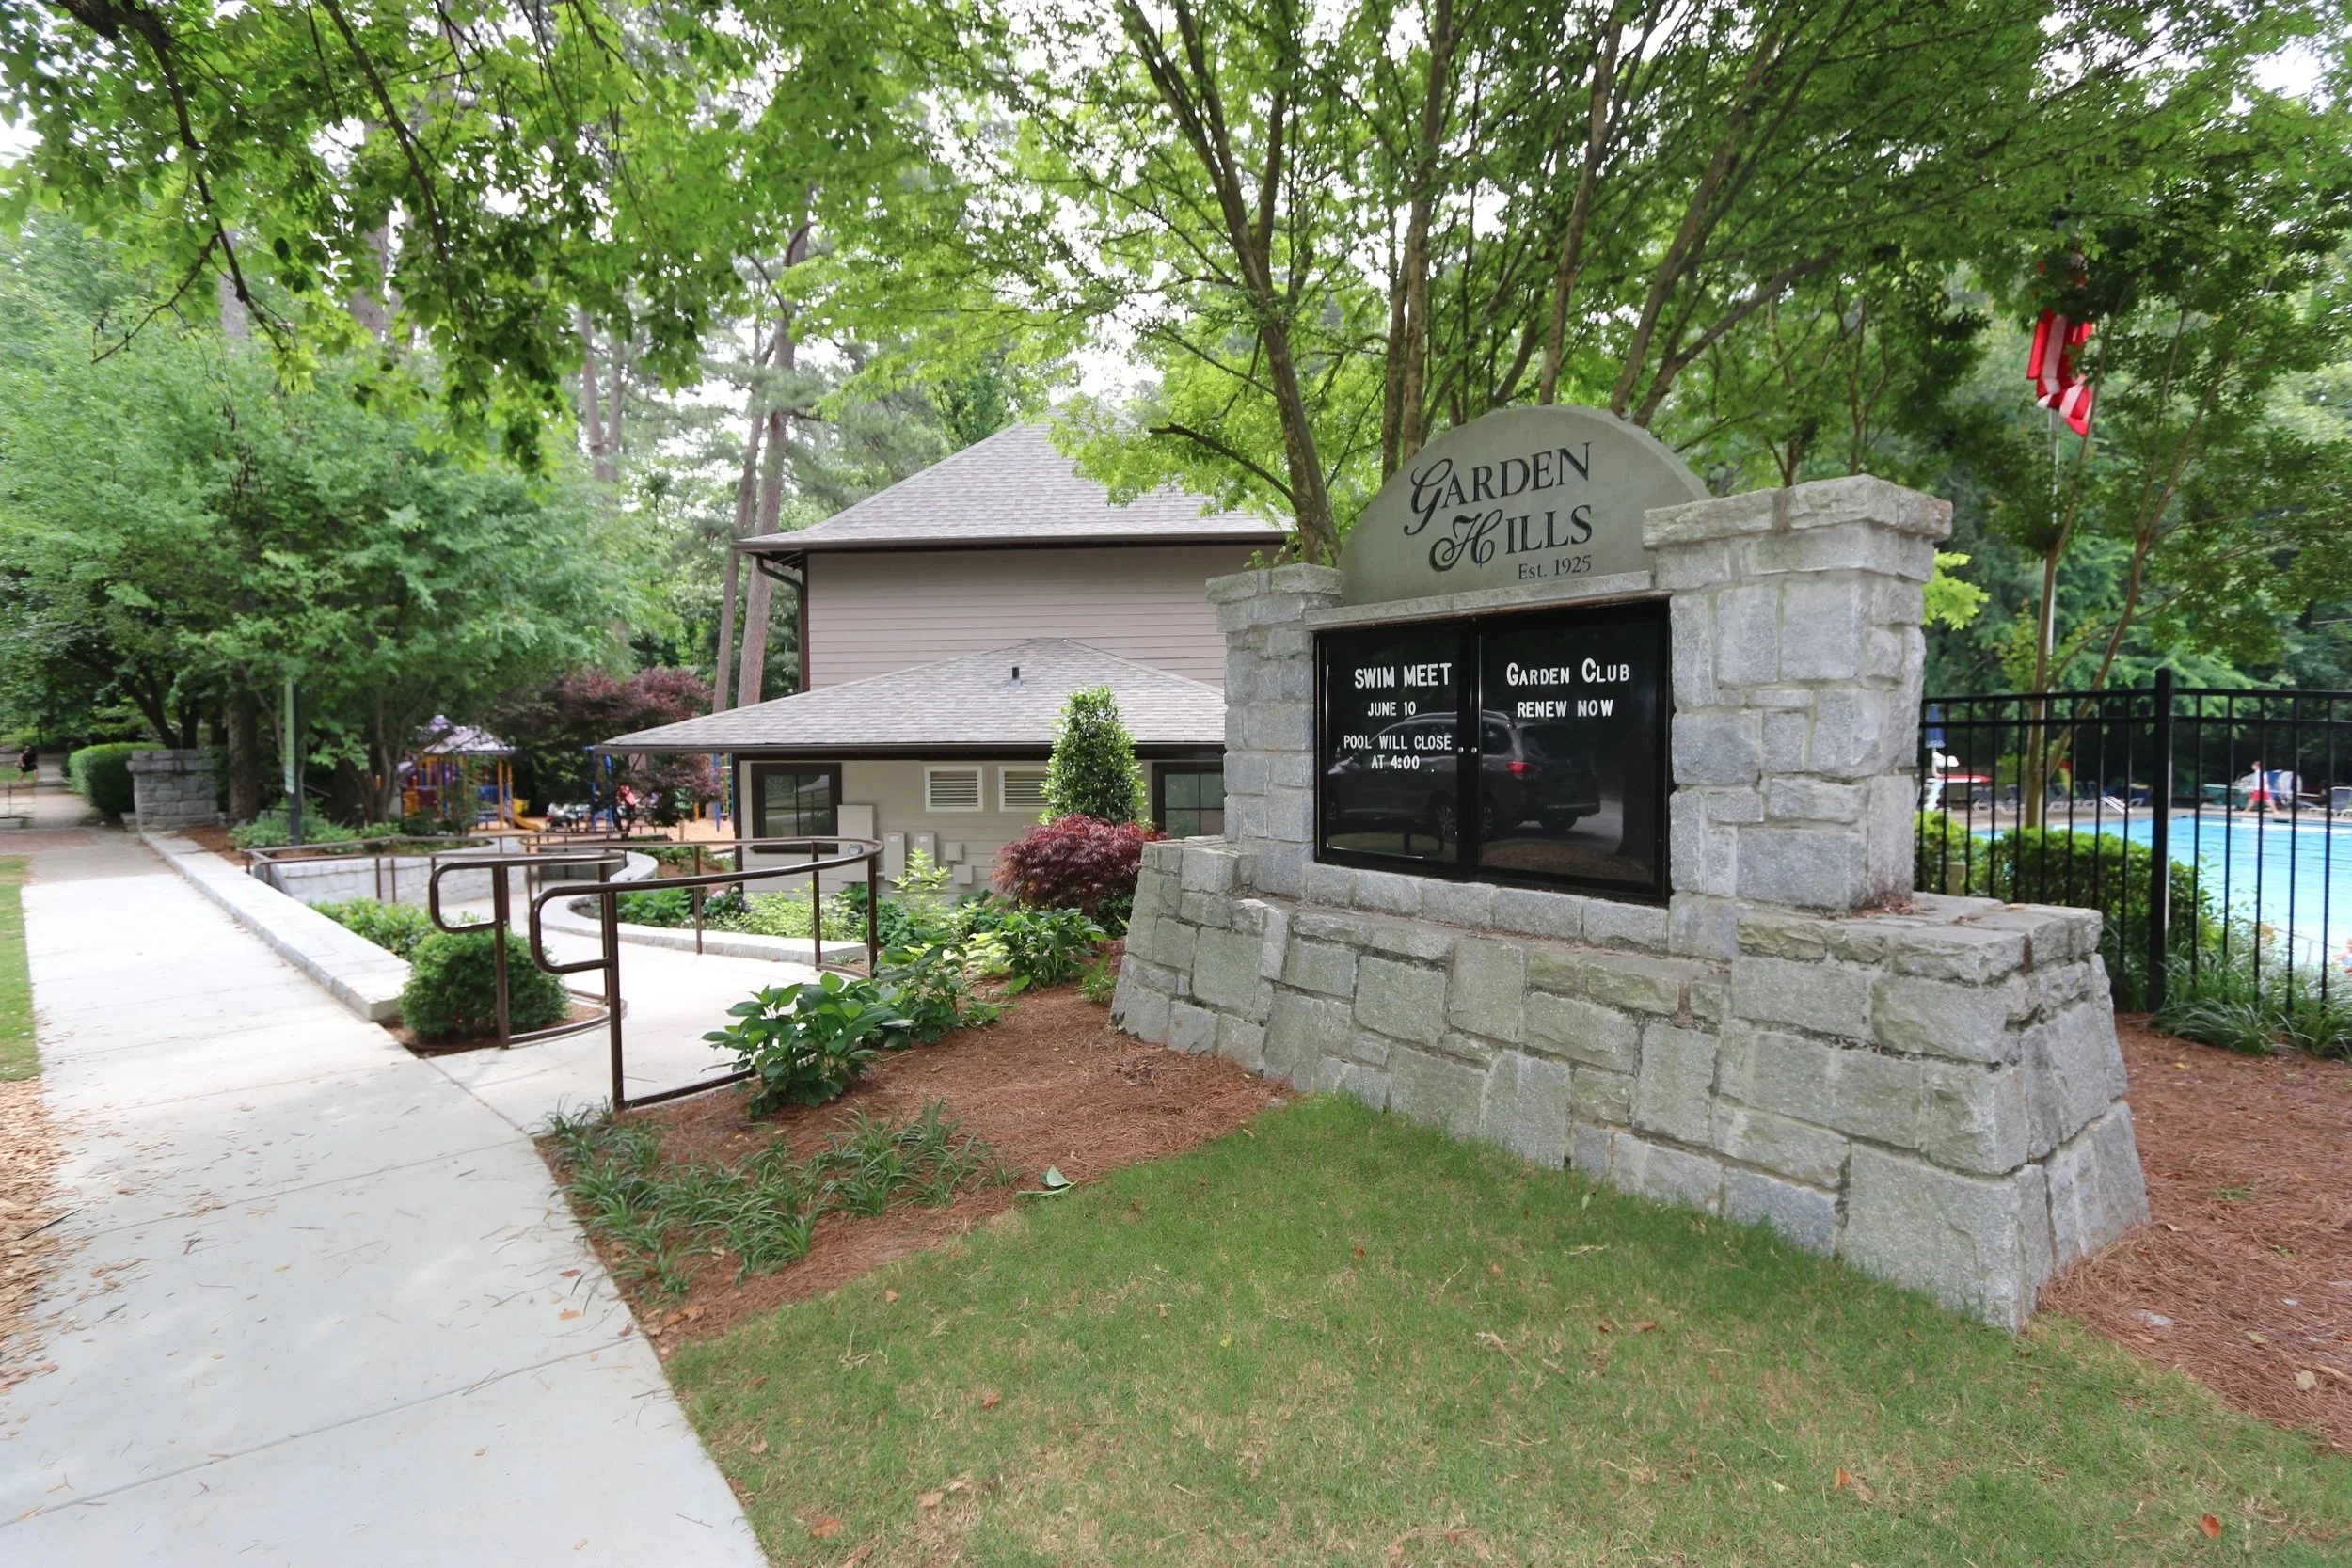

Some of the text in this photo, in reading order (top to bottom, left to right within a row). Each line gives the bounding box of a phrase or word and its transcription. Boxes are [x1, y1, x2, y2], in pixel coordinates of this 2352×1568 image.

[1404, 442, 1593, 535] GARDEN
[1429, 504, 1592, 572] HILLS
[1518, 555, 1592, 579] Est. 1925
[1355, 662, 1452, 689] SWIM MEET
[1506, 657, 1629, 686] GARDEN CLUB
[1367, 701, 1416, 716] JUNE 10
[1517, 699, 1613, 718] RENEW NOW
[1343, 735, 1453, 751] POOL WILL CLOSE
[1371, 755, 1420, 770] AT 4:00
